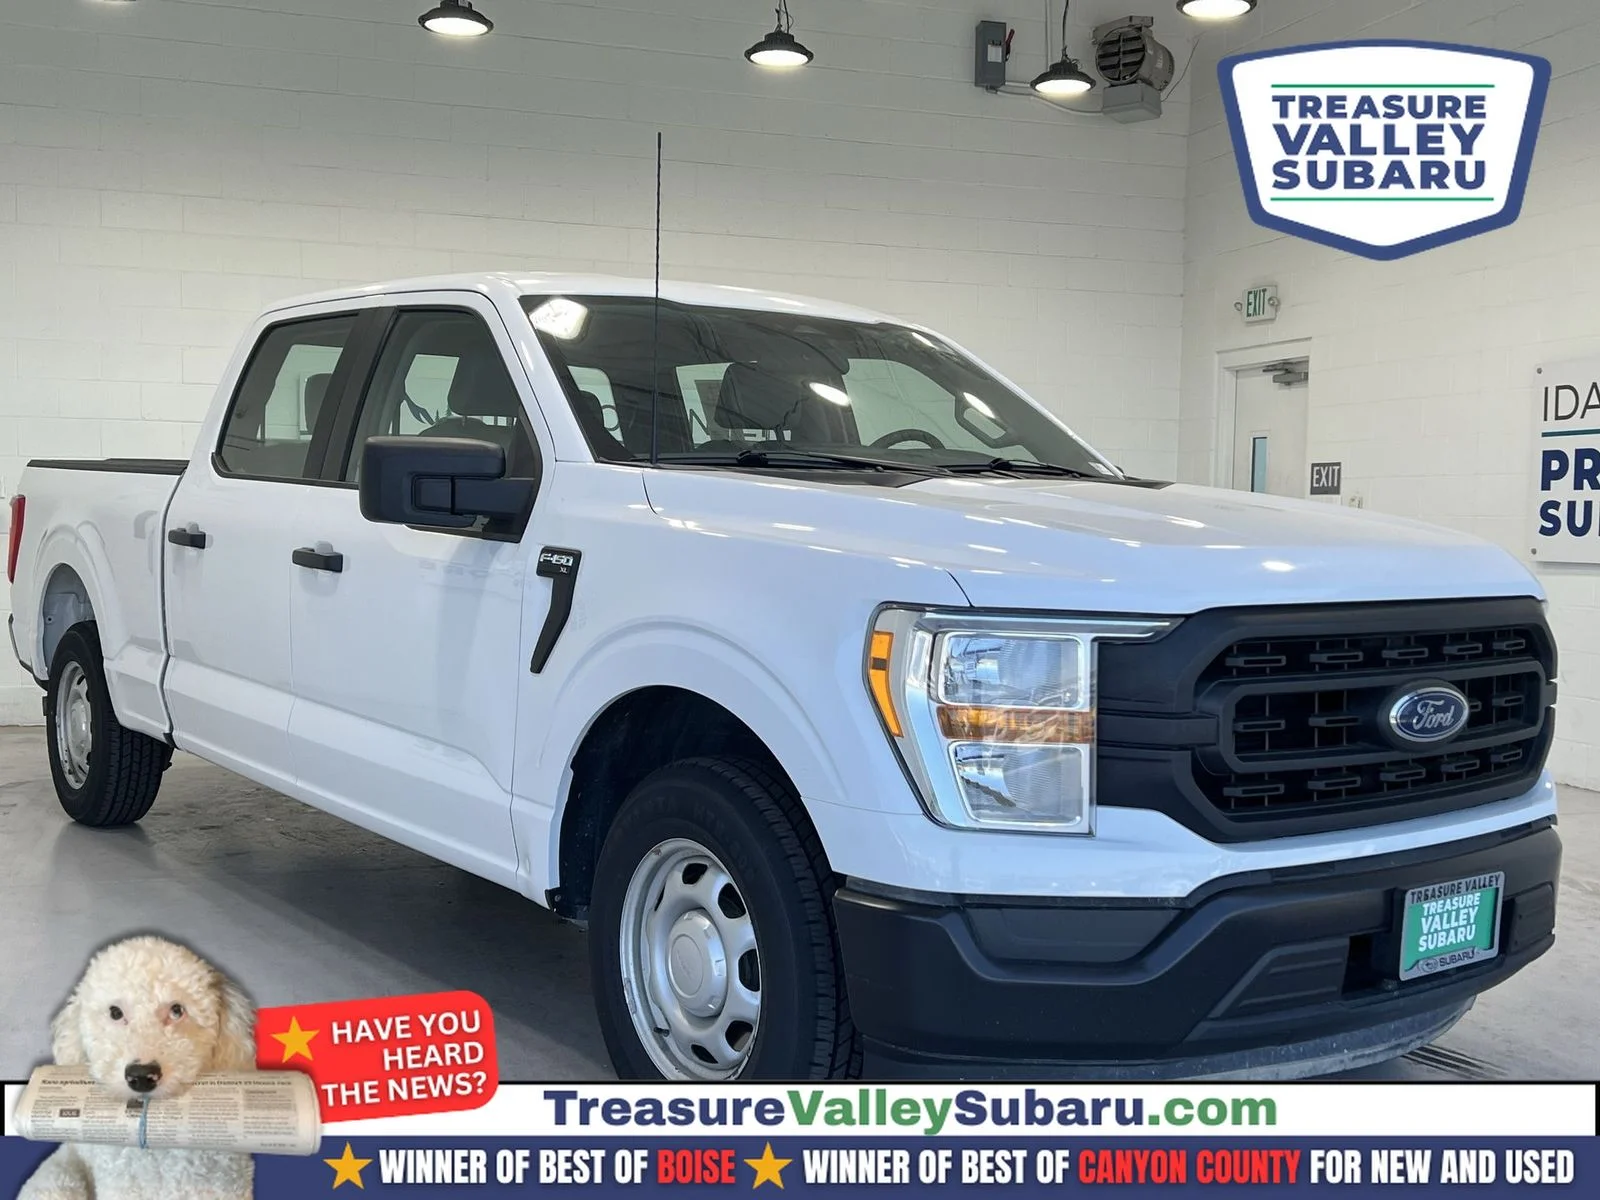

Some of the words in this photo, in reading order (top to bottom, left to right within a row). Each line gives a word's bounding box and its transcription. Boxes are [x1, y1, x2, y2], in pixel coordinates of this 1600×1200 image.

[1246, 288, 1267, 318] EXIT
[1313, 466, 1340, 487] EXIT
[1541, 448, 1600, 491] PR
[1538, 500, 1600, 537] SU
[540, 553, 573, 566] F-150
[560, 566, 568, 574] XL
[1412, 699, 1455, 730] Ford
[1410, 882, 1462, 904] TREASURE
[1465, 874, 1500, 892] VALLEY
[1422, 893, 1481, 916] TREASURE
[1421, 907, 1479, 934] VALLEY
[1418, 925, 1476, 952] SUBARU
[1439, 950, 1476, 968] SUBARU
